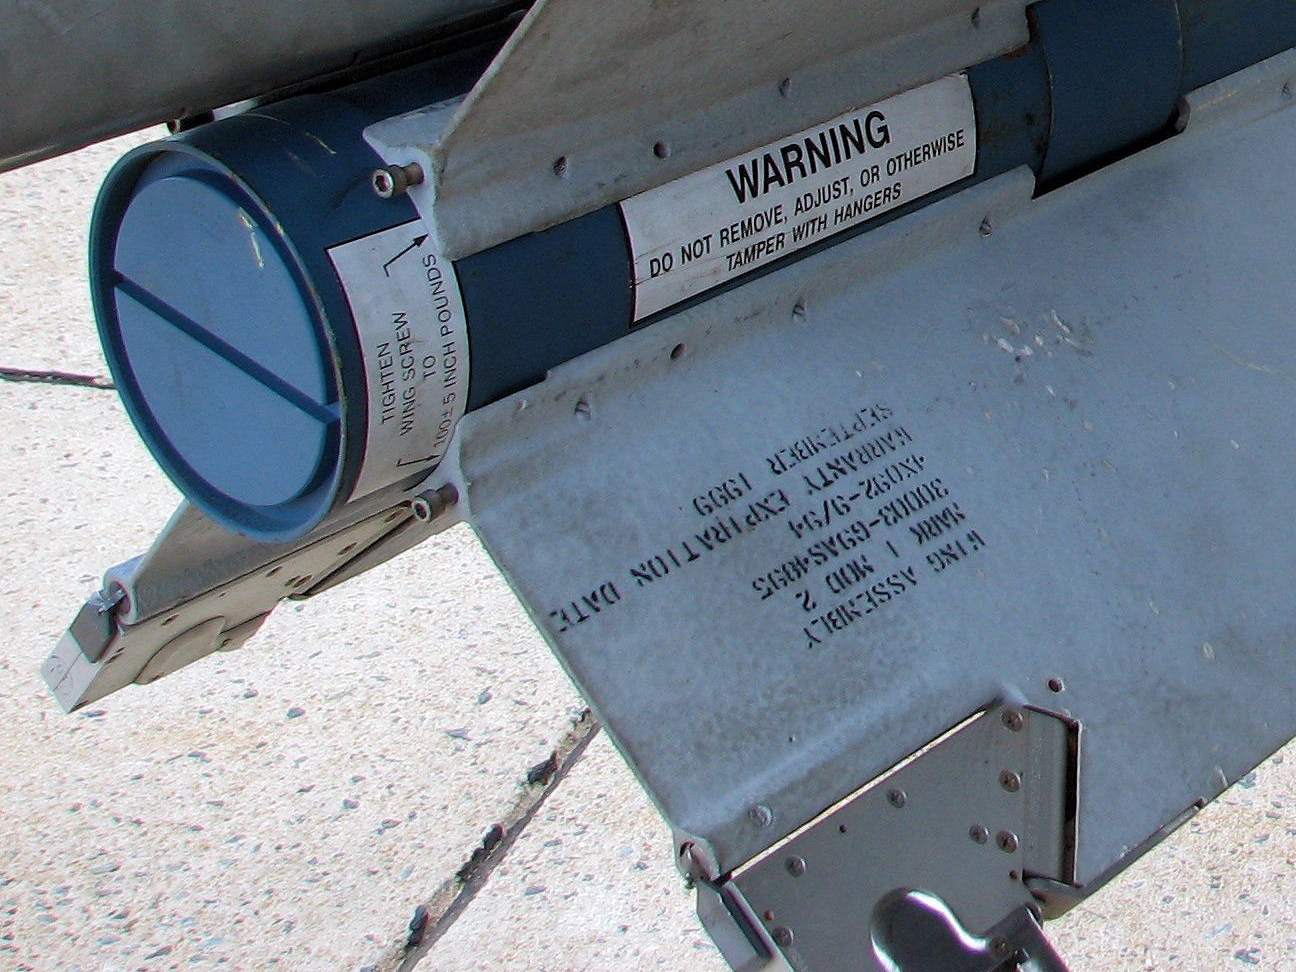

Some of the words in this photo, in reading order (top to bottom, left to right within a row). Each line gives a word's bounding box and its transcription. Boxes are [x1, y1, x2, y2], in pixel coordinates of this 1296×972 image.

[726, 111, 891, 203] WARNING
[650, 252, 673, 278] DO
[681, 234, 713, 263] NOT
[719, 206, 788, 247] REMOVE,
[795, 177, 855, 215] ADJUST,
[860, 165, 880, 187] OR
[886, 129, 965, 176] OTHERWISE
[726, 235, 785, 272] TAMPER
[792, 215, 827, 243] WITH
[834, 183, 902, 229] HANGERS
[422, 253, 455, 335] POUNDS
[392, 312, 416, 382] SCREW
[422, 355, 437, 380] TO
[442, 342, 457, 387] INCH
[377, 342, 397, 425] TIGHTEN
[400, 390, 417, 437] WING
[766, 402, 894, 476] SEPTEMBER
[804, 426, 913, 495] WARRANTY
[693, 471, 752, 517] 1999
[909, 501, 967, 545] MARK
[630, 488, 790, 587] EXPIRATION
[928, 529, 986, 572] WING
[549, 580, 621, 632] DATE
[795, 590, 817, 613] 2
[802, 565, 917, 649] ASSEMBLY
[825, 553, 875, 594] MOD
